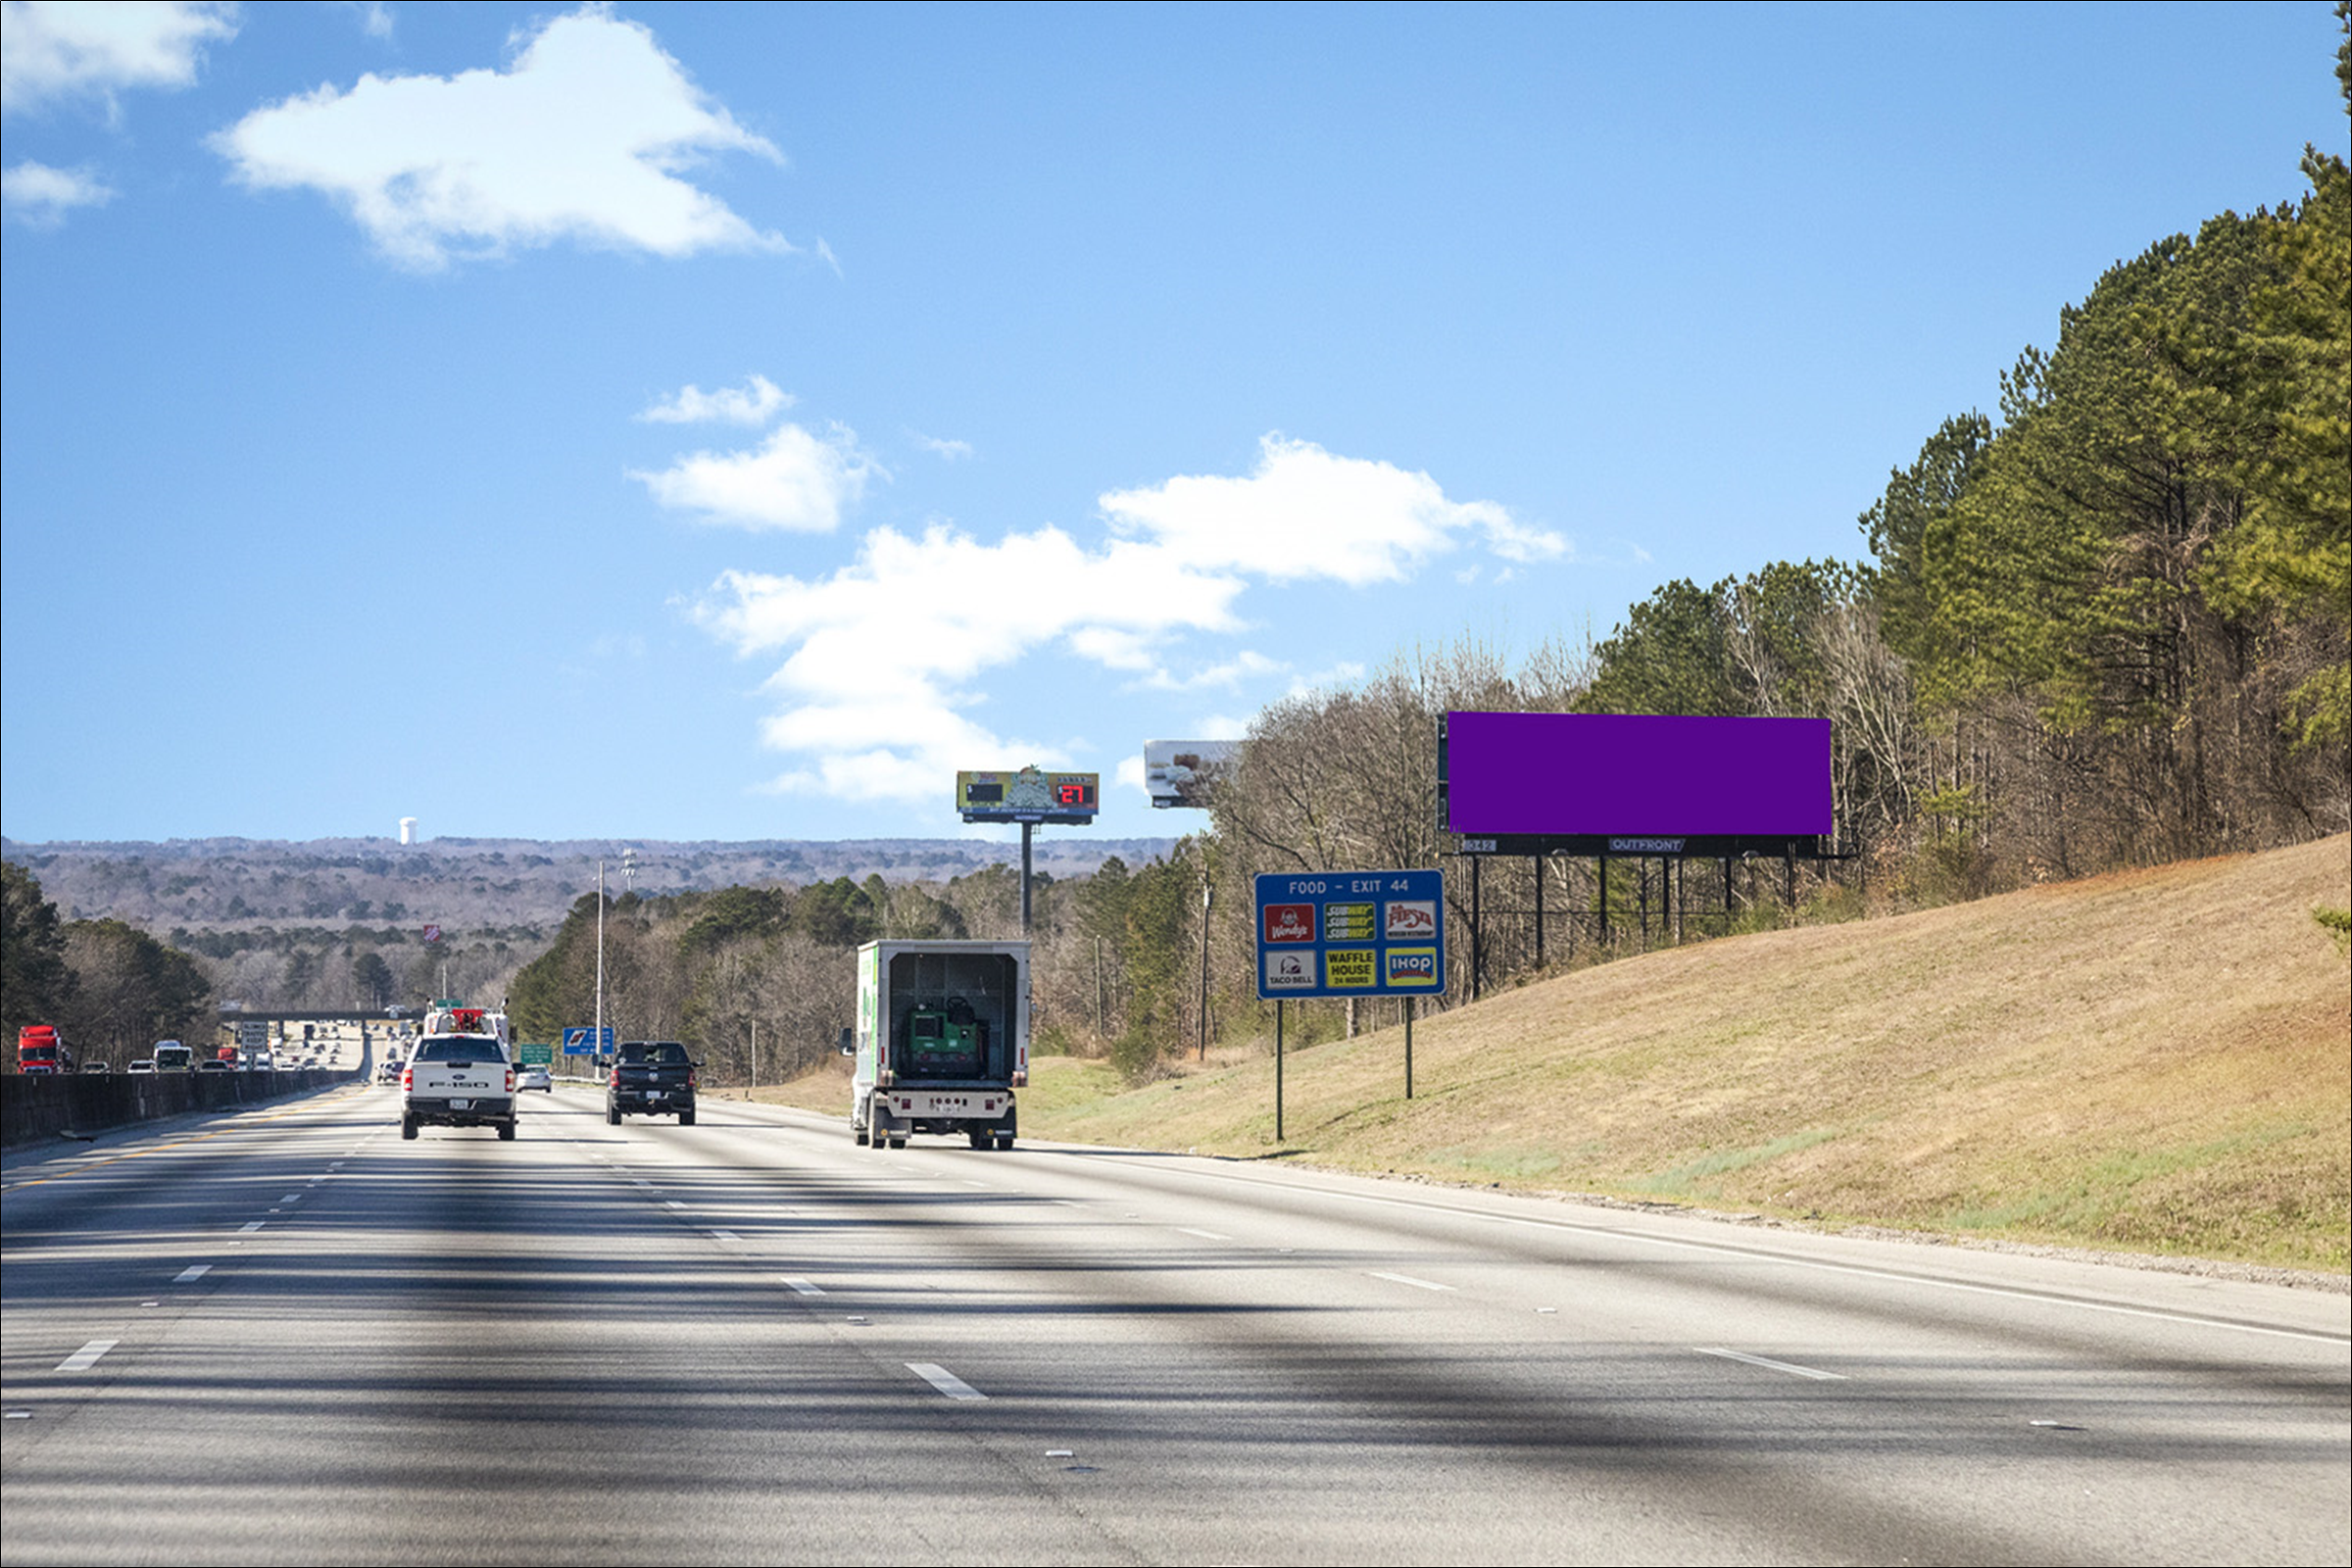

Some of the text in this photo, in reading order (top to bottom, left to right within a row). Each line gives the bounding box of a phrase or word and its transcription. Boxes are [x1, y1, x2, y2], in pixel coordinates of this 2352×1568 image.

[1612, 839, 1682, 851] OUTFRONT
[1289, 881, 1327, 894] FOOD
[1351, 880, 1382, 893] EXIT
[1390, 879, 1409, 892] 44
[1327, 906, 1373, 916] SUBWAY
[1327, 916, 1373, 927] SUBWAY
[1328, 927, 1374, 938] SUBWAY
[1328, 953, 1374, 963] WAFFLE
[1331, 964, 1372, 975] HOUSE
[1392, 957, 1431, 971] IHOP
